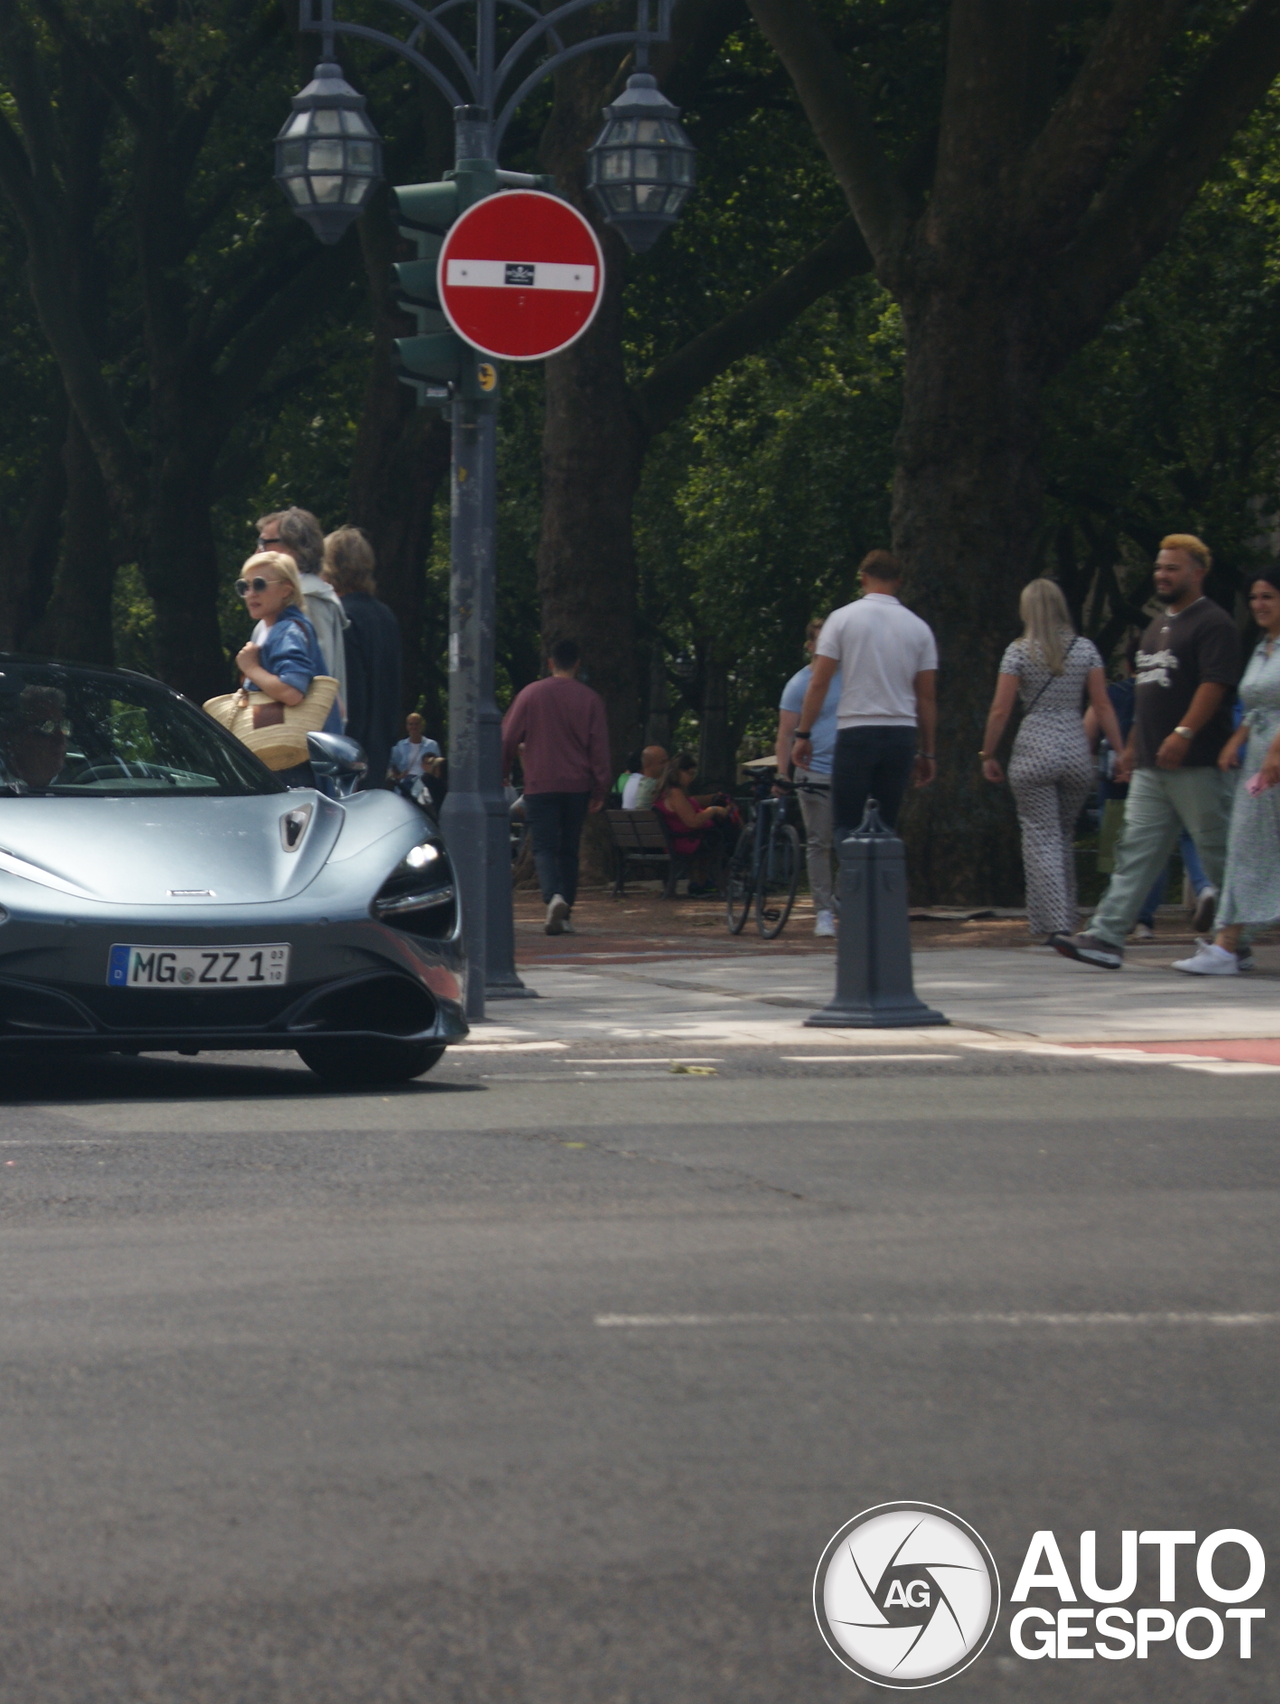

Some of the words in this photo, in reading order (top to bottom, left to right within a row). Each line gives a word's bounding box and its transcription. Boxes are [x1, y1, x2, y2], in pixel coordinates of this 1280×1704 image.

[271, 950, 284, 960] 03
[132, 952, 177, 983] MG
[198, 952, 240, 983] ZZ
[247, 951, 265, 982] 1
[114, 970, 123, 979] D
